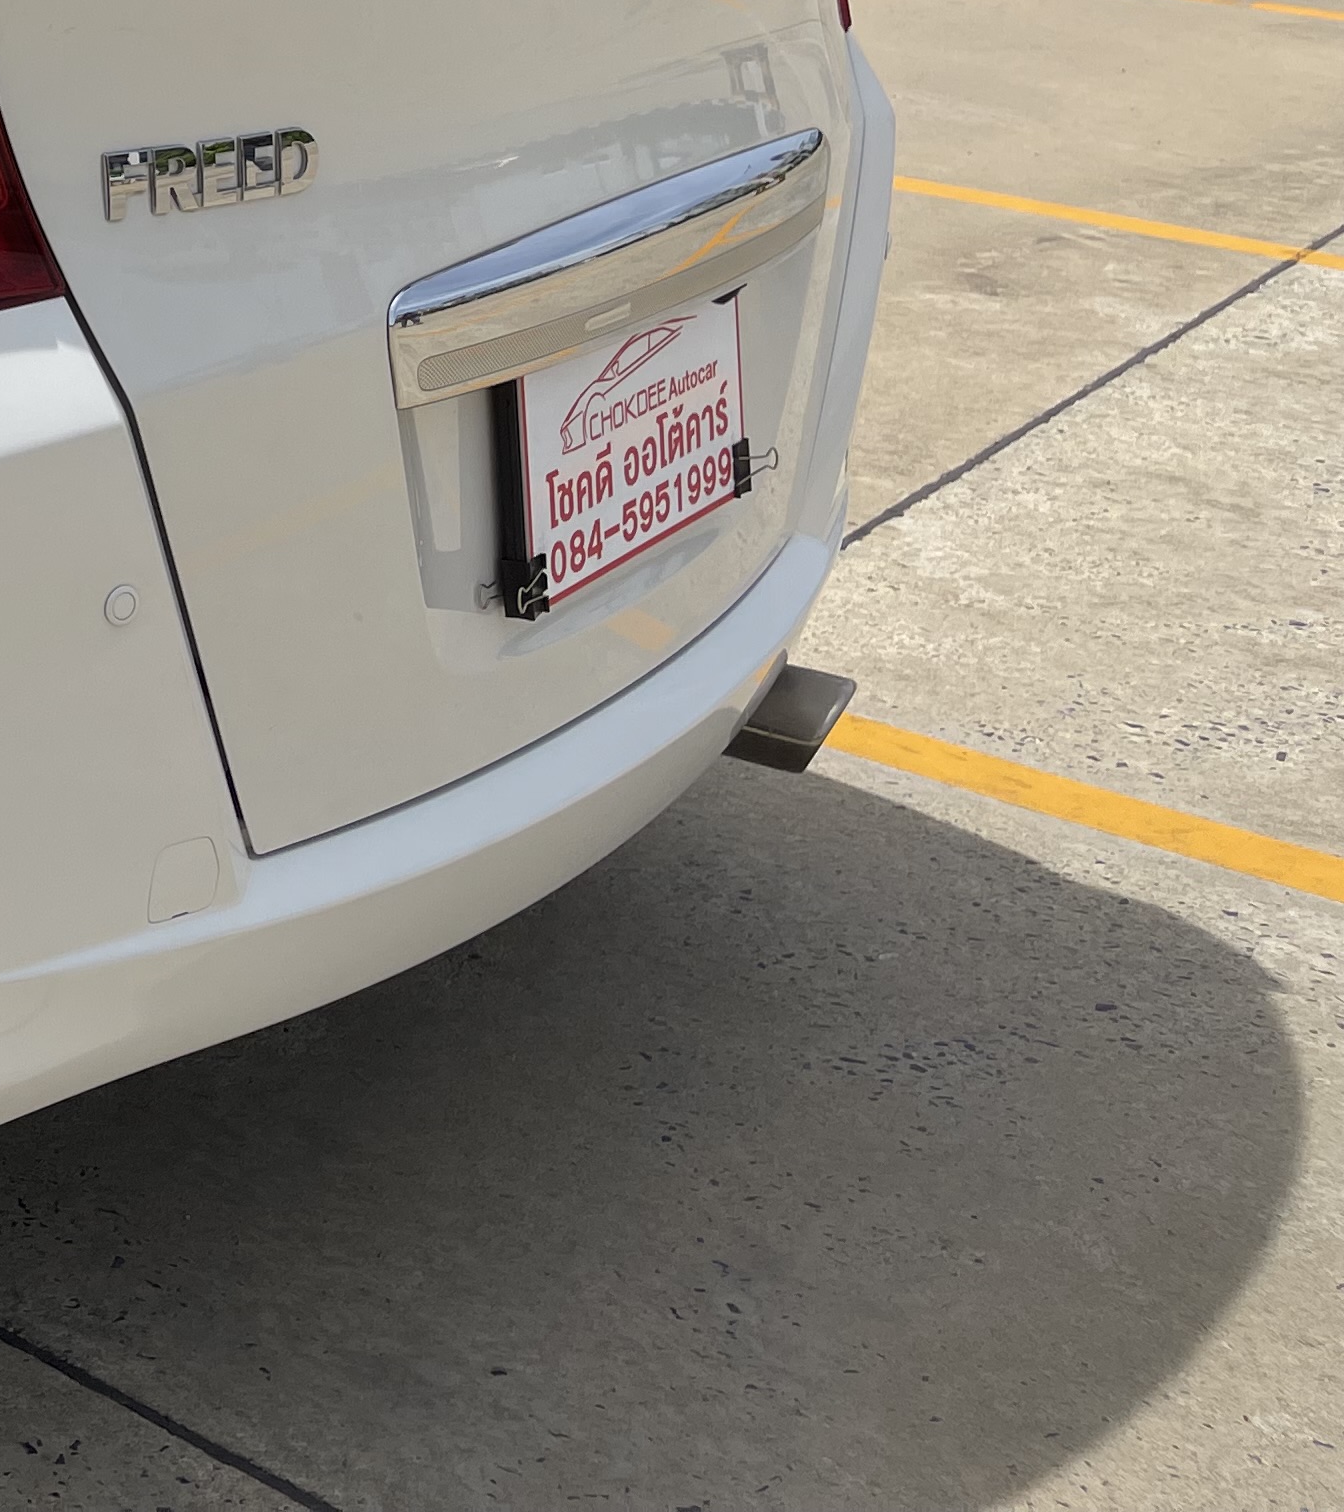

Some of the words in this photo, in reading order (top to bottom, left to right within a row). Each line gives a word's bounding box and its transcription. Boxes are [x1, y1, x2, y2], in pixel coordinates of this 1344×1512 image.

[100, 126, 320, 222] FREED
[545, 441, 613, 529] โชคดี
[623, 380, 729, 487] ออโต้คาร์
[589, 378, 667, 441] CHOKDEE
[668, 360, 718, 401] Autocar
[550, 446, 732, 584] 084-5951999
